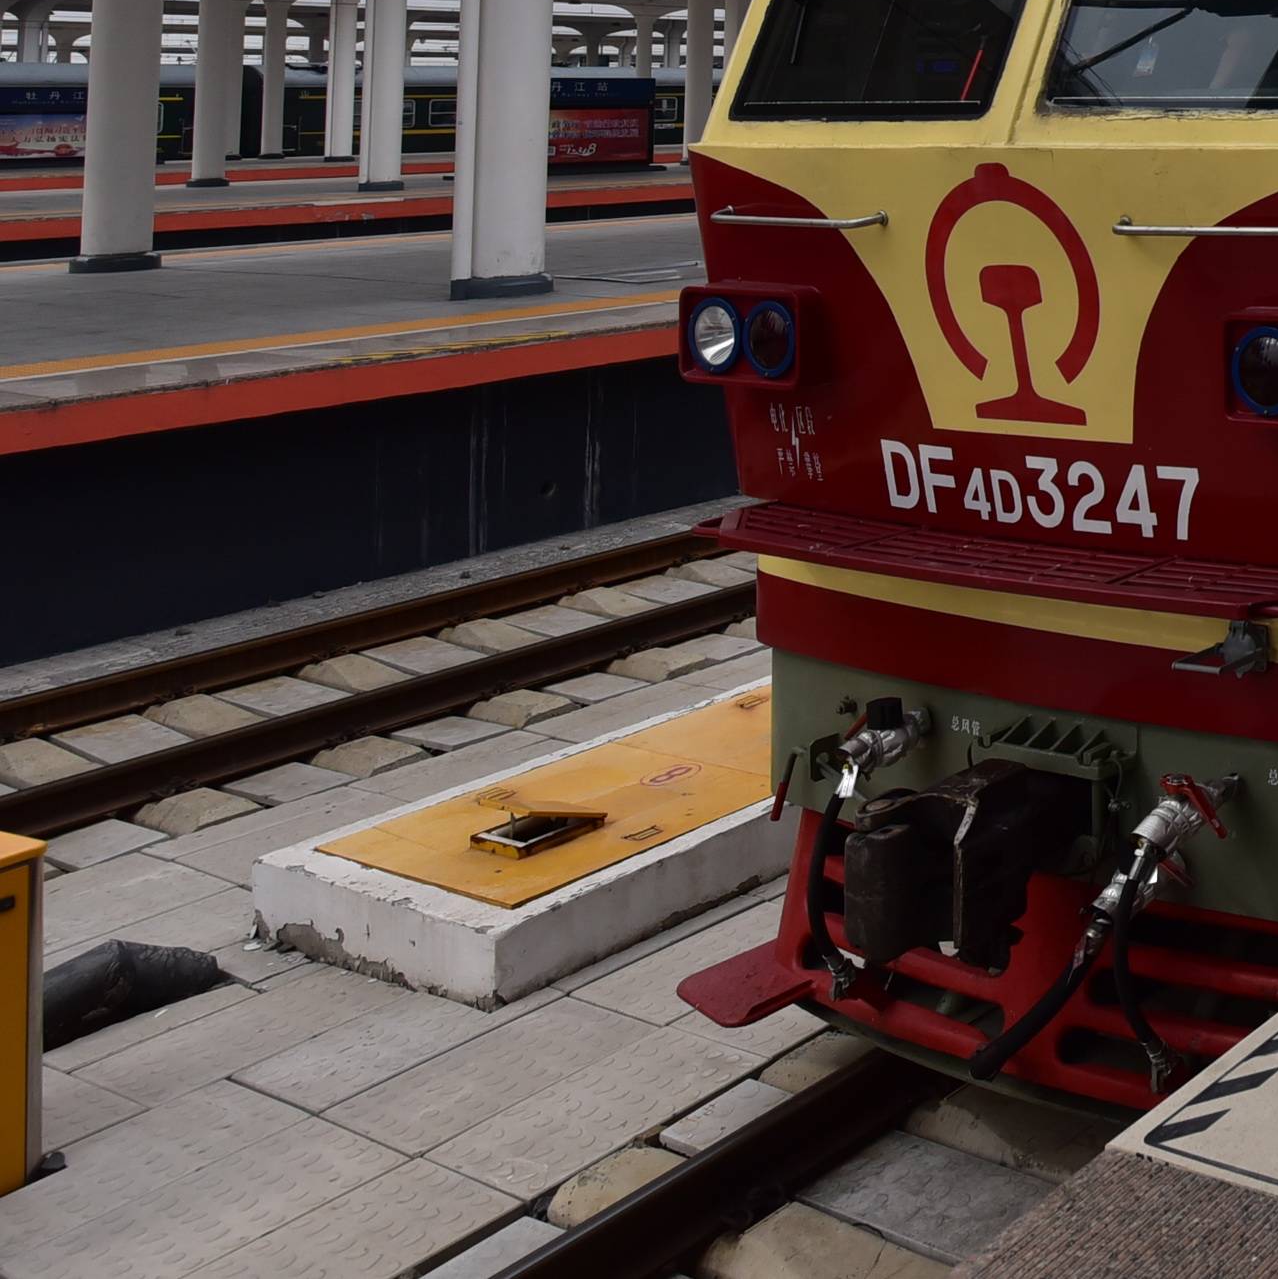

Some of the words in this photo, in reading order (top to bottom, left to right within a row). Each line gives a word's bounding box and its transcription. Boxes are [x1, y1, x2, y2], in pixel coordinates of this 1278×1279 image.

[25, 91, 86, 101] 牡丹江
[880, 438, 1200, 541] DF4D3247
